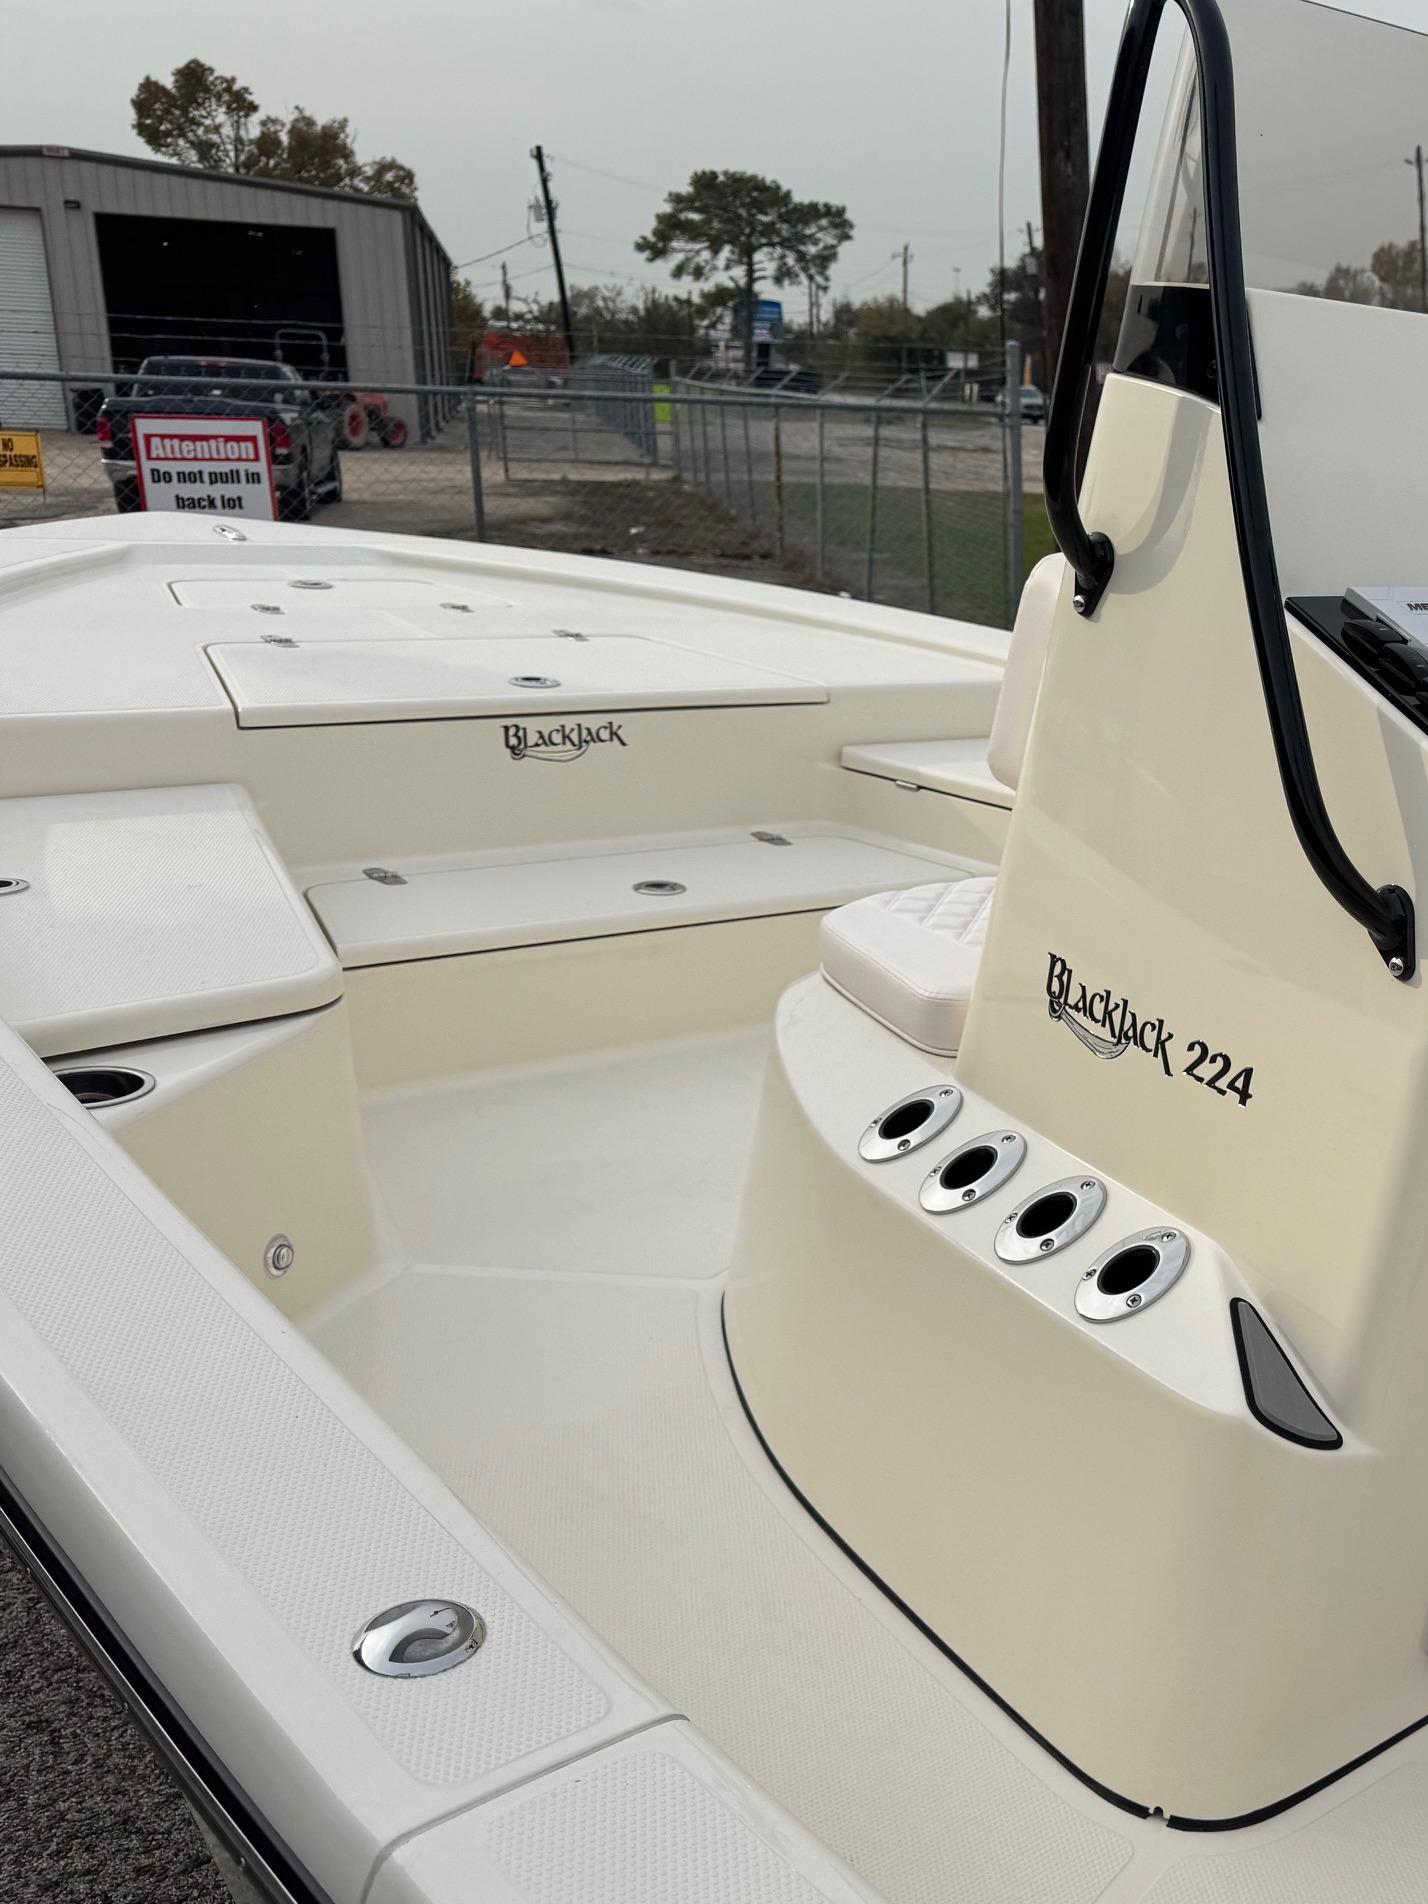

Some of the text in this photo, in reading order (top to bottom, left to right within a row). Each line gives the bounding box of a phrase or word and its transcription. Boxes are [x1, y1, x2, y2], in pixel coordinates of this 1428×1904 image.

[2, 438, 14, 452] NO
[150, 436, 256, 460] Attention
[150, 468, 261, 486] Do not pull in
[175, 494, 244, 510] back lot
[1182, 1039, 1254, 1108] 224
